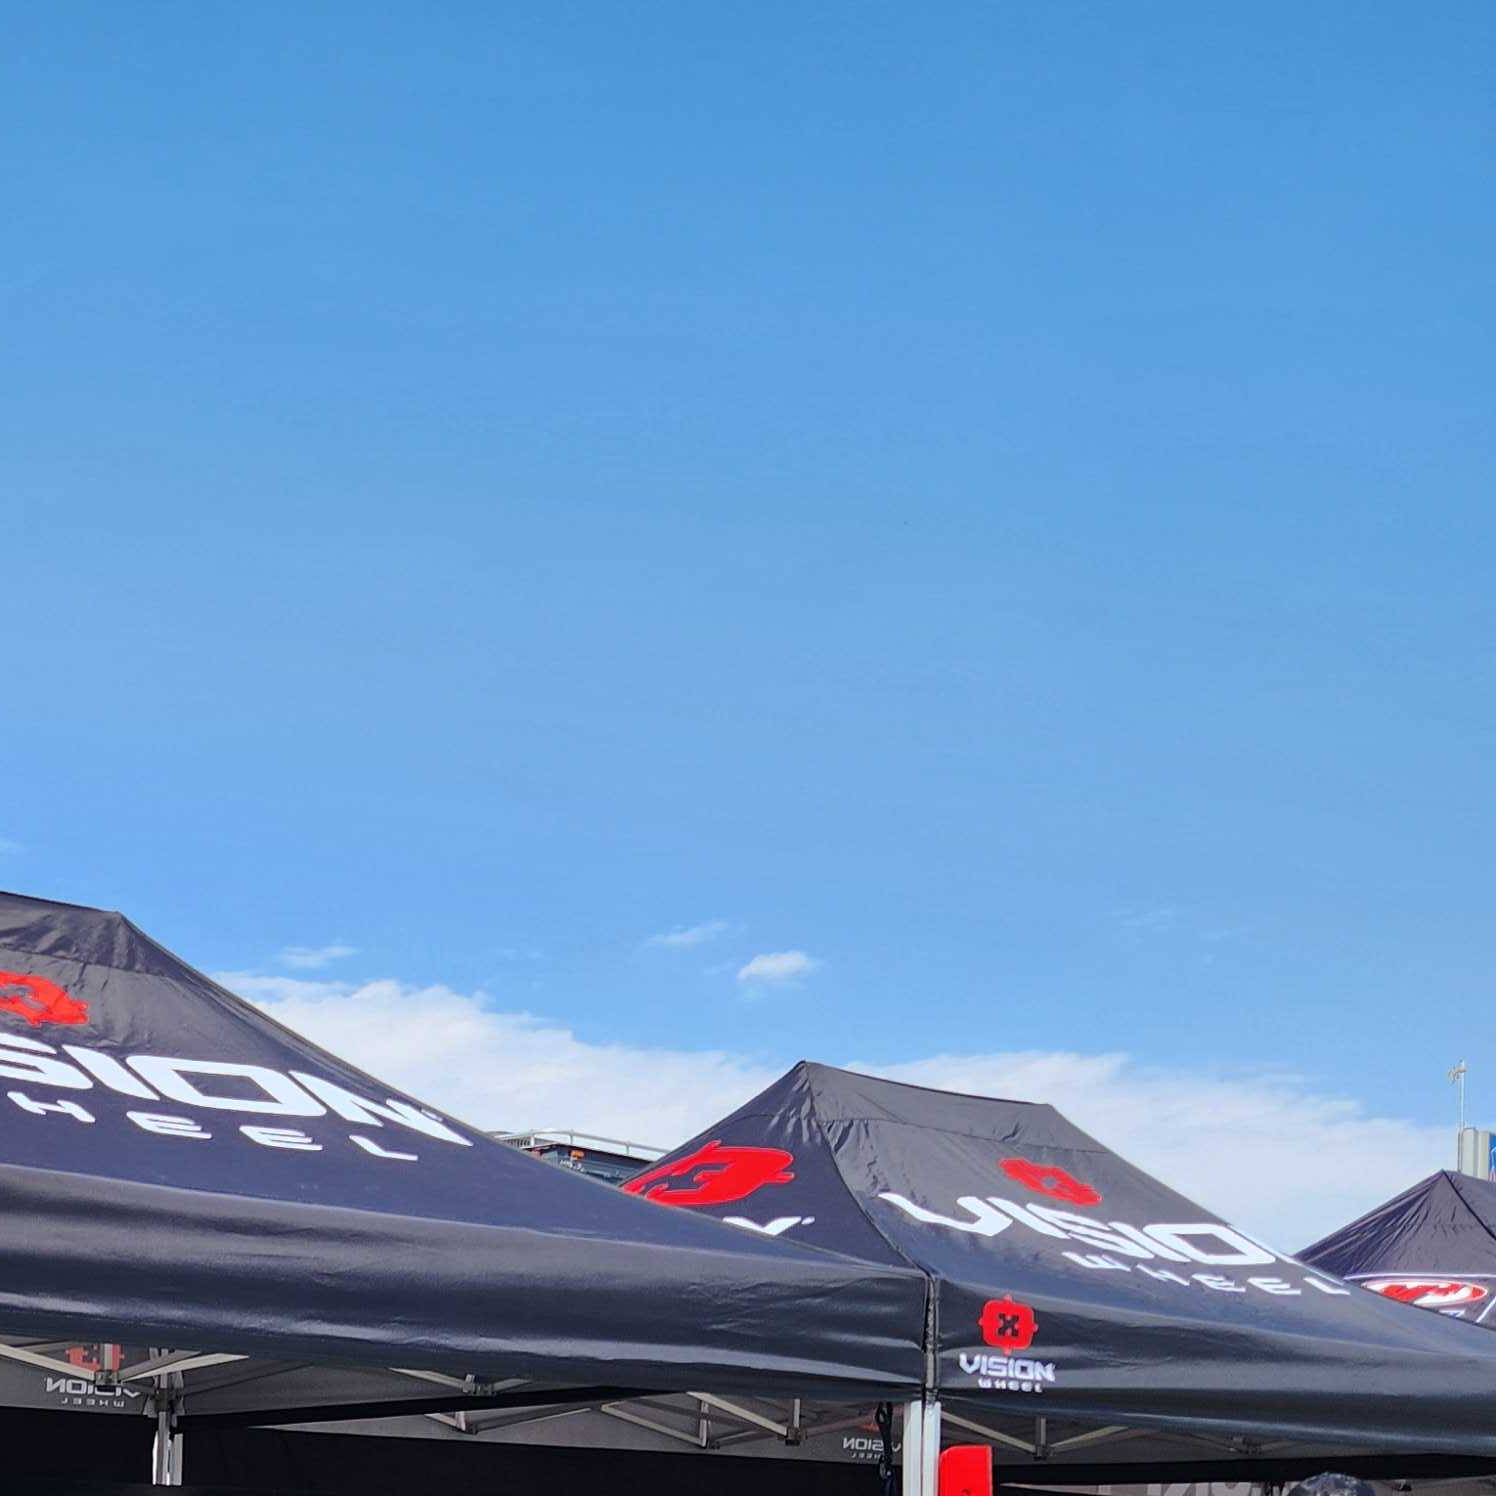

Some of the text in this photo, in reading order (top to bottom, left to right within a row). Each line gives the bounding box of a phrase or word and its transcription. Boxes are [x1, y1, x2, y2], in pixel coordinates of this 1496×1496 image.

[877, 1193, 1346, 1288] VISIO
[959, 1352, 1055, 1382] VISION
[978, 1379, 1042, 1393] WHEEL
